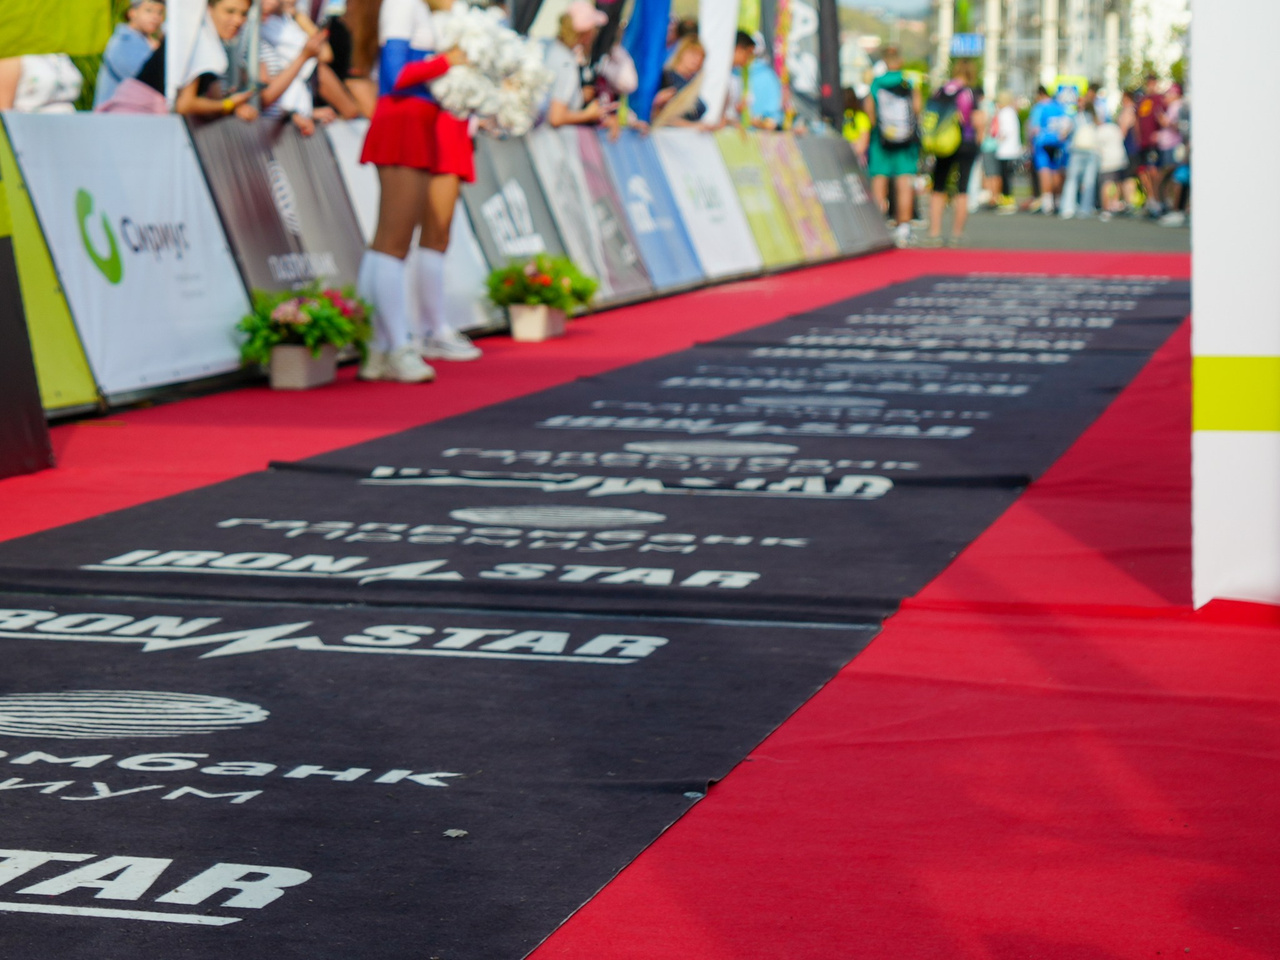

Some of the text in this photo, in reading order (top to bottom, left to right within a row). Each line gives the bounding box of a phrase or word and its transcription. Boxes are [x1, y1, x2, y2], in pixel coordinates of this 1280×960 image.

[101, 549, 762, 589] IRON STAR
[342, 625, 670, 657] STAR
